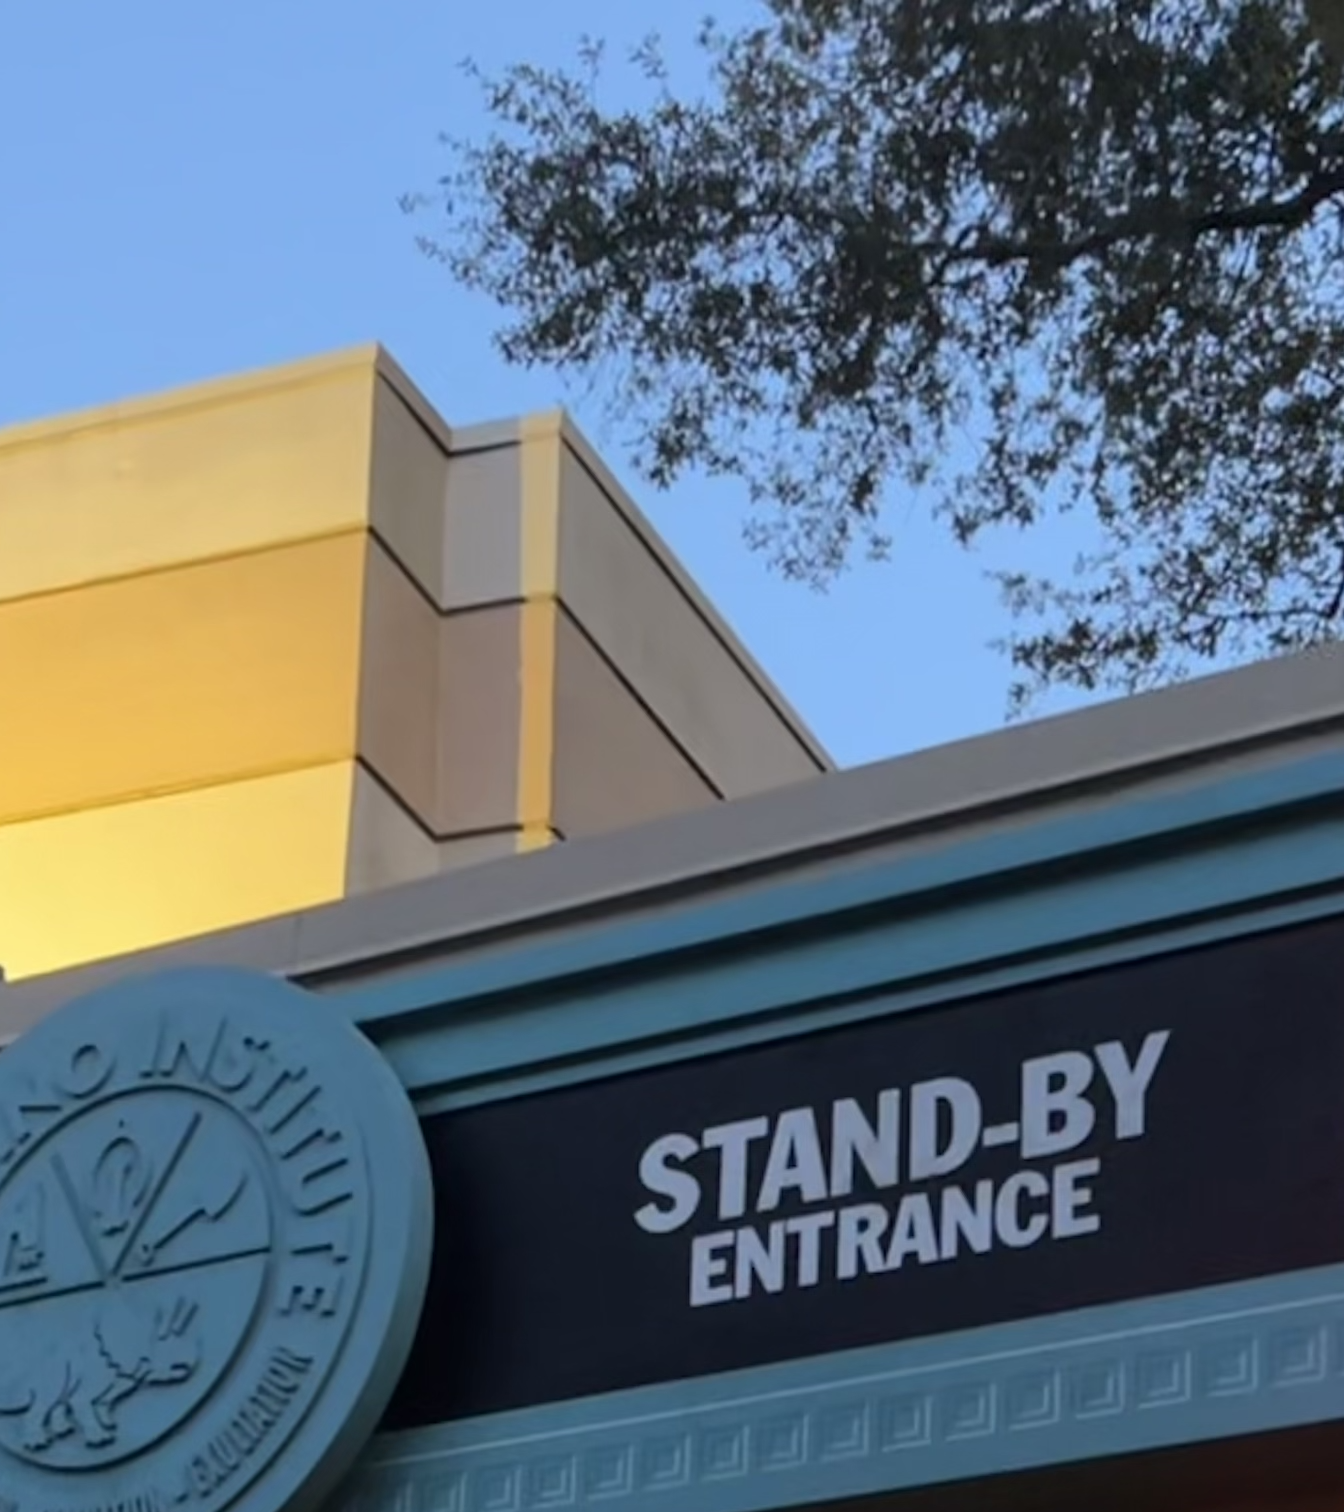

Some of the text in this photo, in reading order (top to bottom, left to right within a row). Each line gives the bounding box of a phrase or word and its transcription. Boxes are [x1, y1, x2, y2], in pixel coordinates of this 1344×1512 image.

[138, 1008, 355, 1320] INSTITUTE
[634, 1030, 1171, 1234] STAND-BY
[689, 1157, 1101, 1307] ENTRANCE
